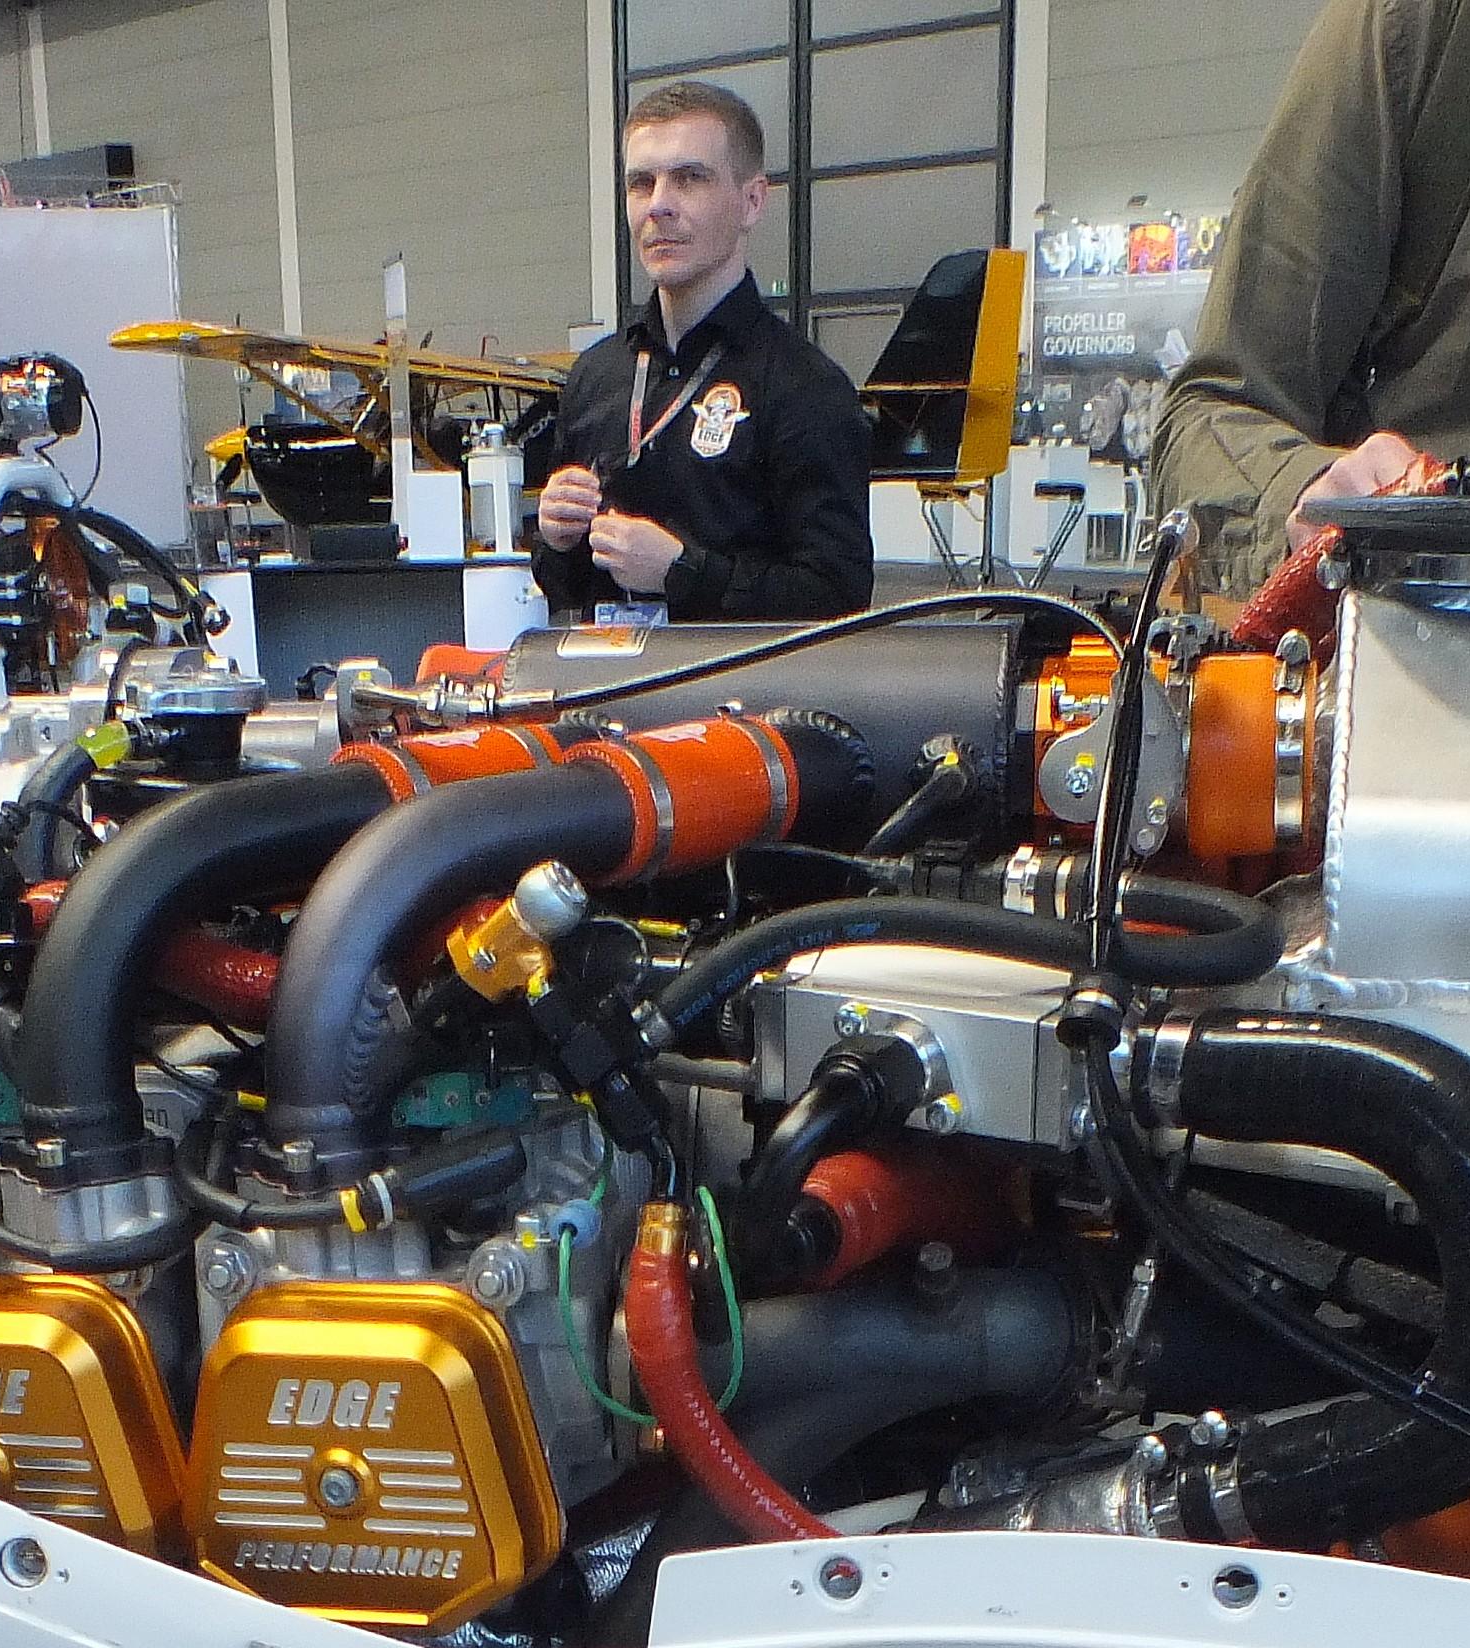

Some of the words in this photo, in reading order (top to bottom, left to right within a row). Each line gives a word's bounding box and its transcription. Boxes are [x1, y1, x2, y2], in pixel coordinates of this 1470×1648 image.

[1044, 312, 1127, 334] PROPELLER
[1043, 335, 1136, 357] GOVERNORS
[267, 1378, 402, 1430] EDGE
[235, 1540, 463, 1580] PERFORMANCE
